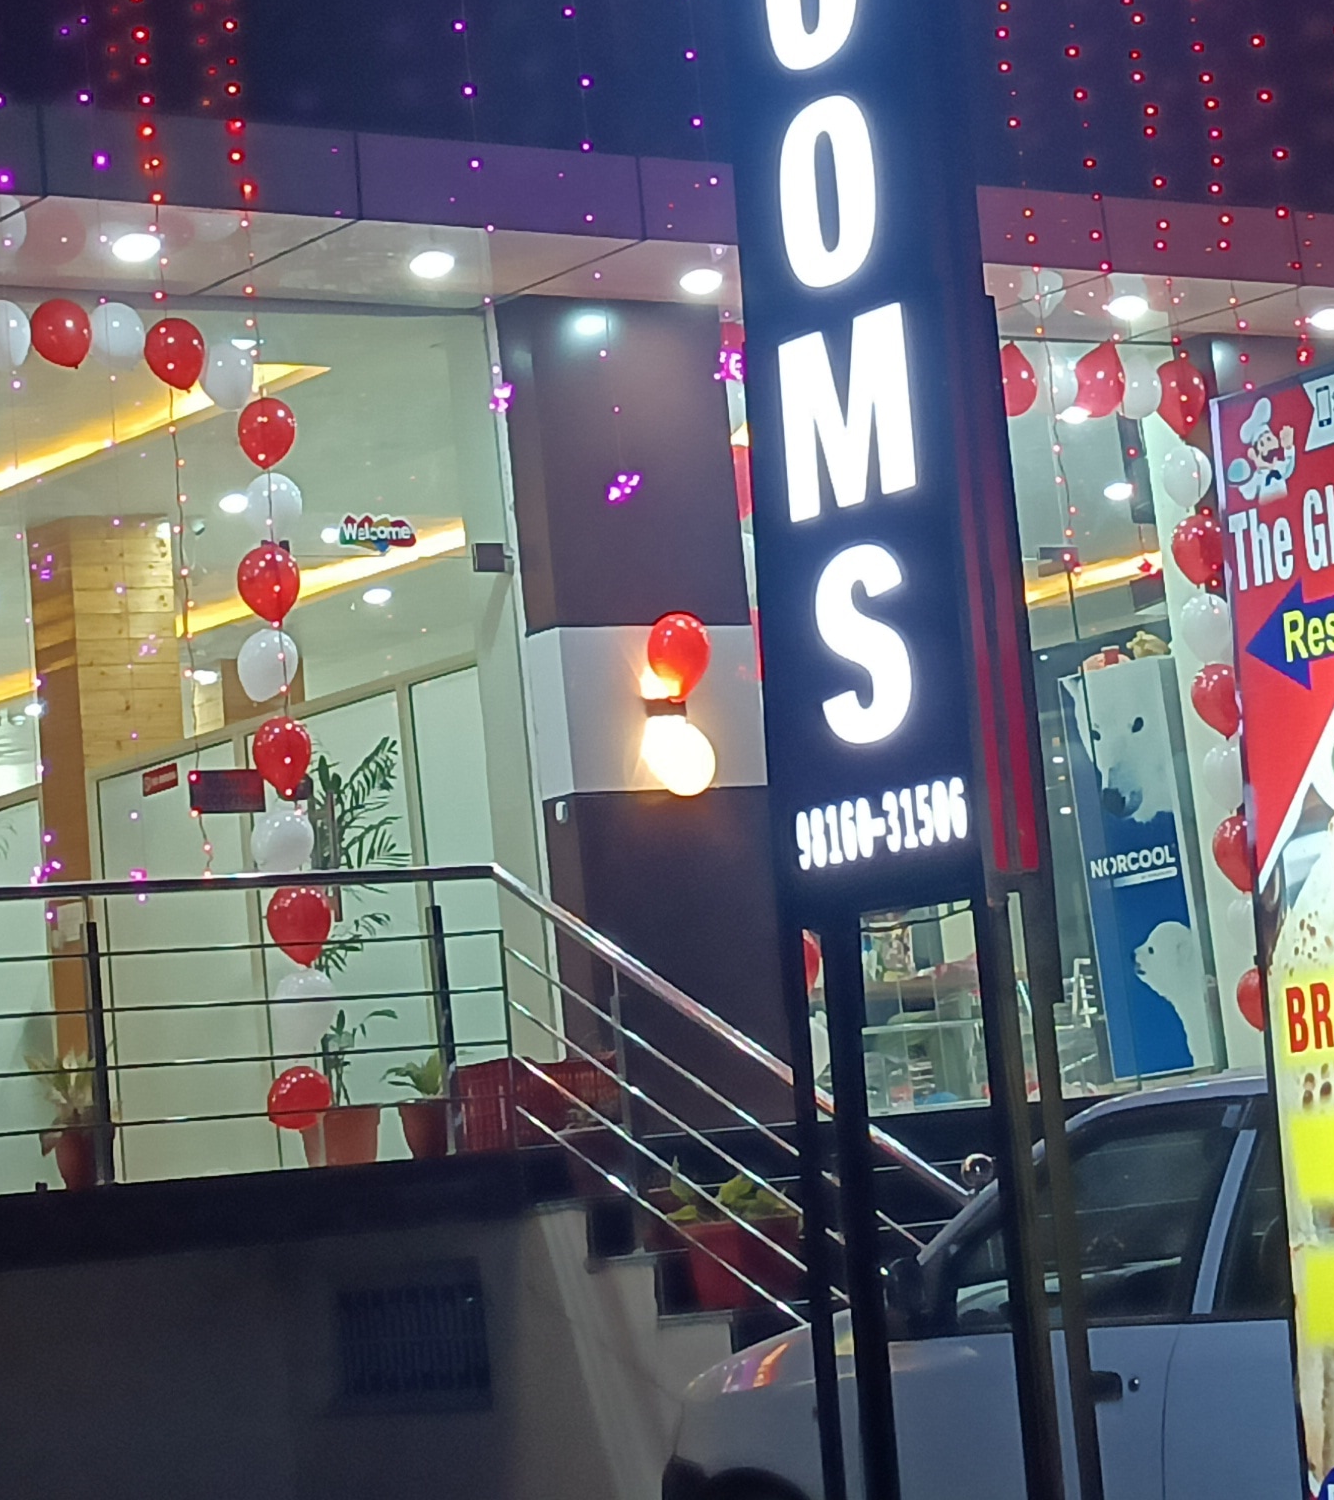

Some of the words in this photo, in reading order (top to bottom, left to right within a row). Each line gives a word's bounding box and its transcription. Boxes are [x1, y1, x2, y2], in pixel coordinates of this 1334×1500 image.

[342, 522, 412, 541] Welcome
[1228, 508, 1295, 591] The
[796, 776, 968, 871] 98160-31506
[1090, 845, 1176, 879] NORCOOL
